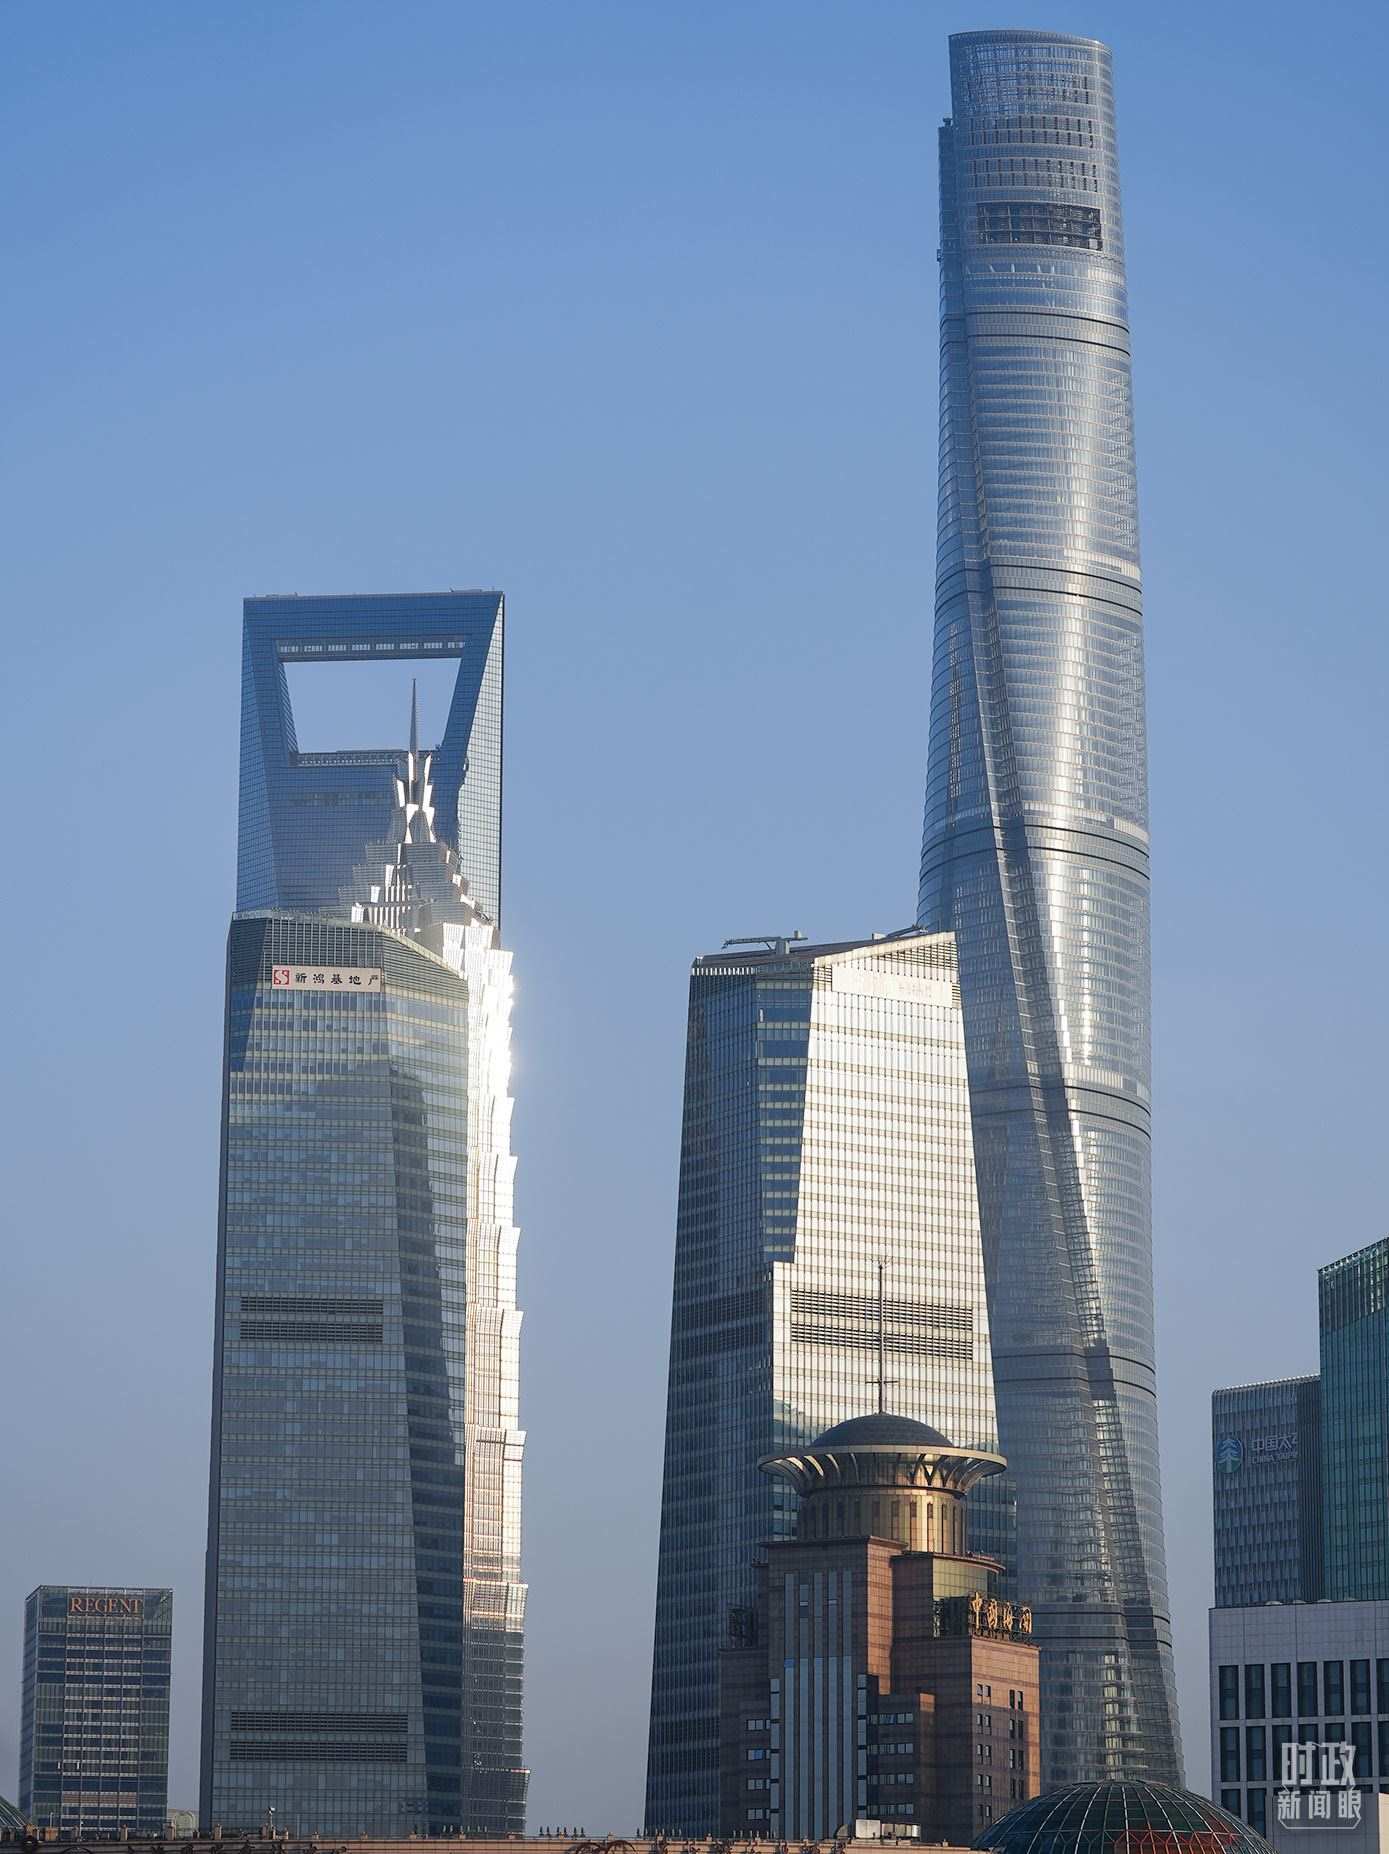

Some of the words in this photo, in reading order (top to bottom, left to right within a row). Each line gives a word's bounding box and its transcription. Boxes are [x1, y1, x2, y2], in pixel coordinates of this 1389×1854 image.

[295, 972, 379, 986] 新鸿基地产
[70, 1597, 144, 1613] REGENT
